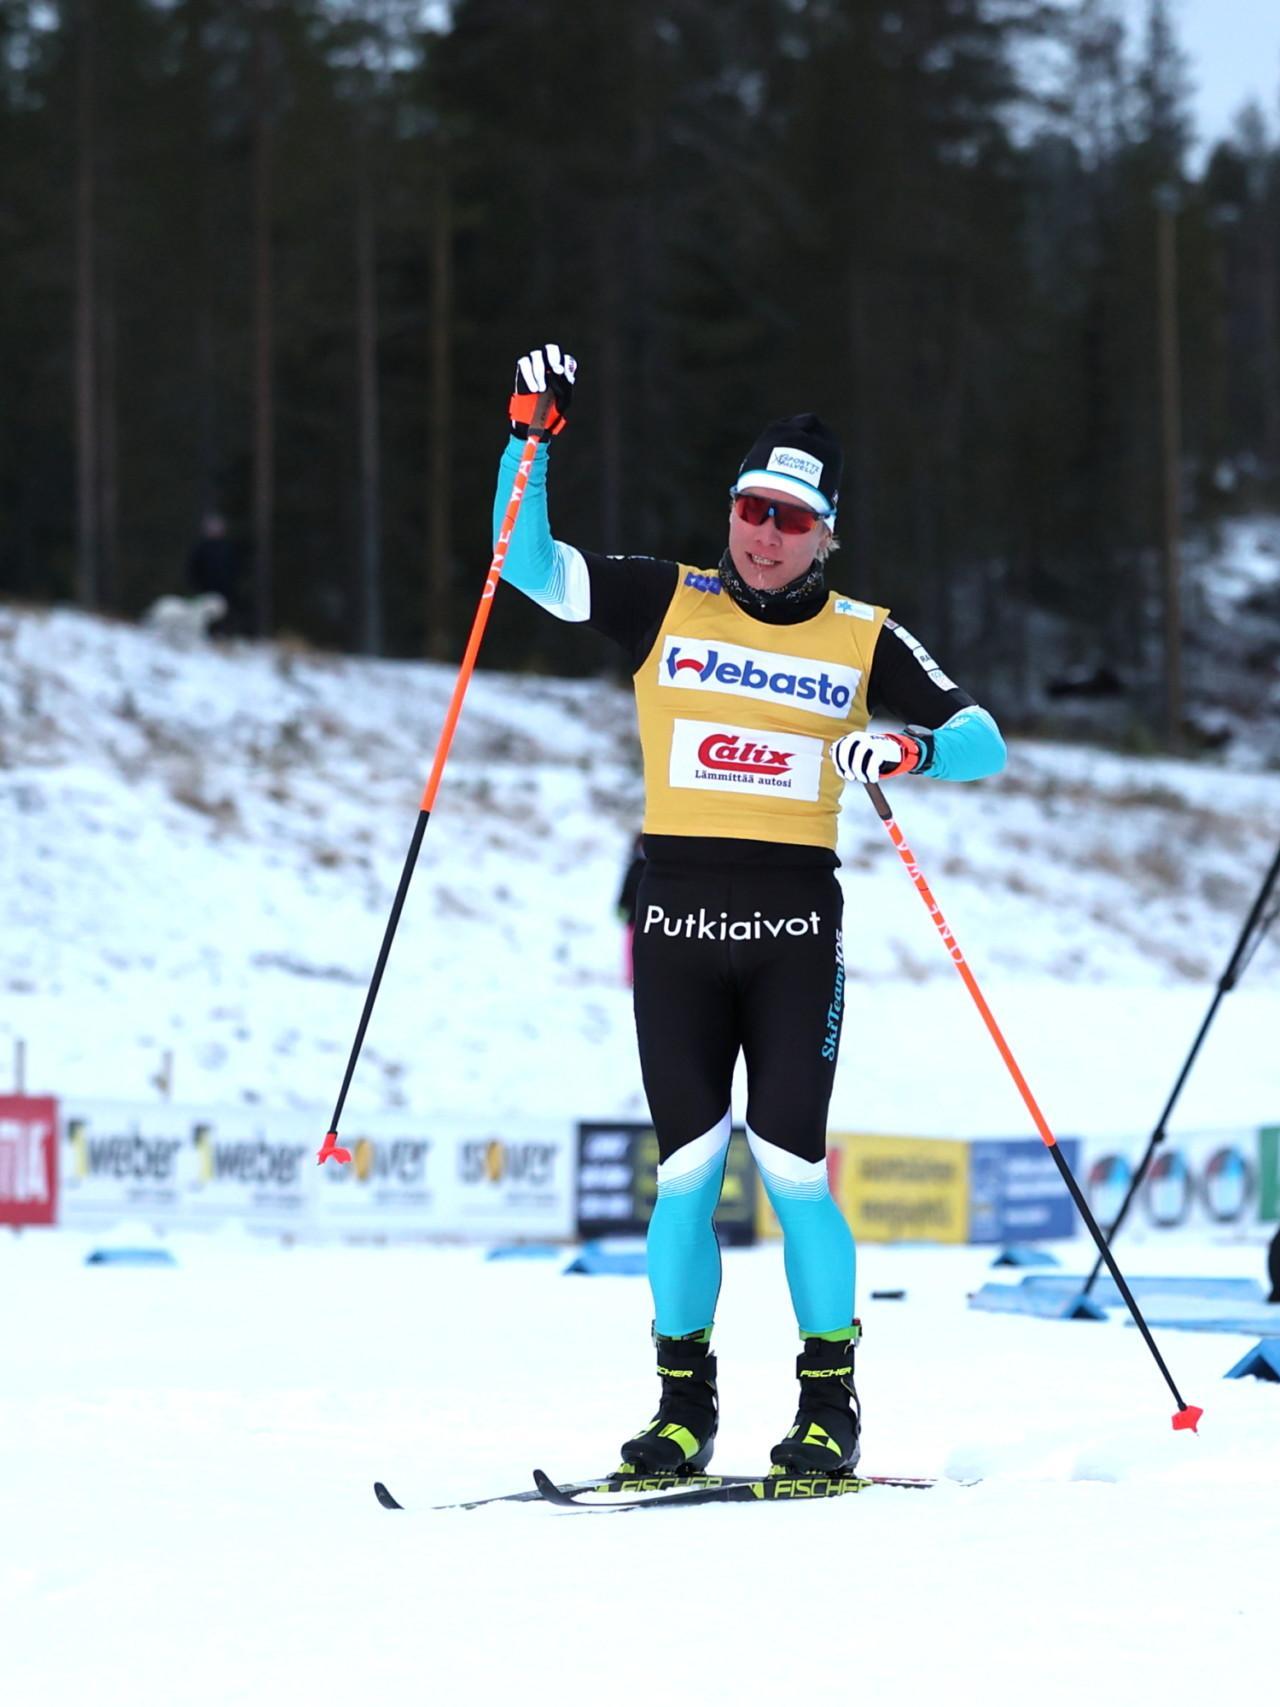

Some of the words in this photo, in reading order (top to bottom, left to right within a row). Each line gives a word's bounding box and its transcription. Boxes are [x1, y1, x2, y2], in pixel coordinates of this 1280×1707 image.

[666, 646, 850, 709] Webasto
[698, 733, 797, 776] Calix
[694, 768, 755, 785] Lämmittää
[757, 775, 792, 788] autosi
[643, 904, 821, 941] Putkiaivot
[799, 1366, 852, 1378] FISCHER
